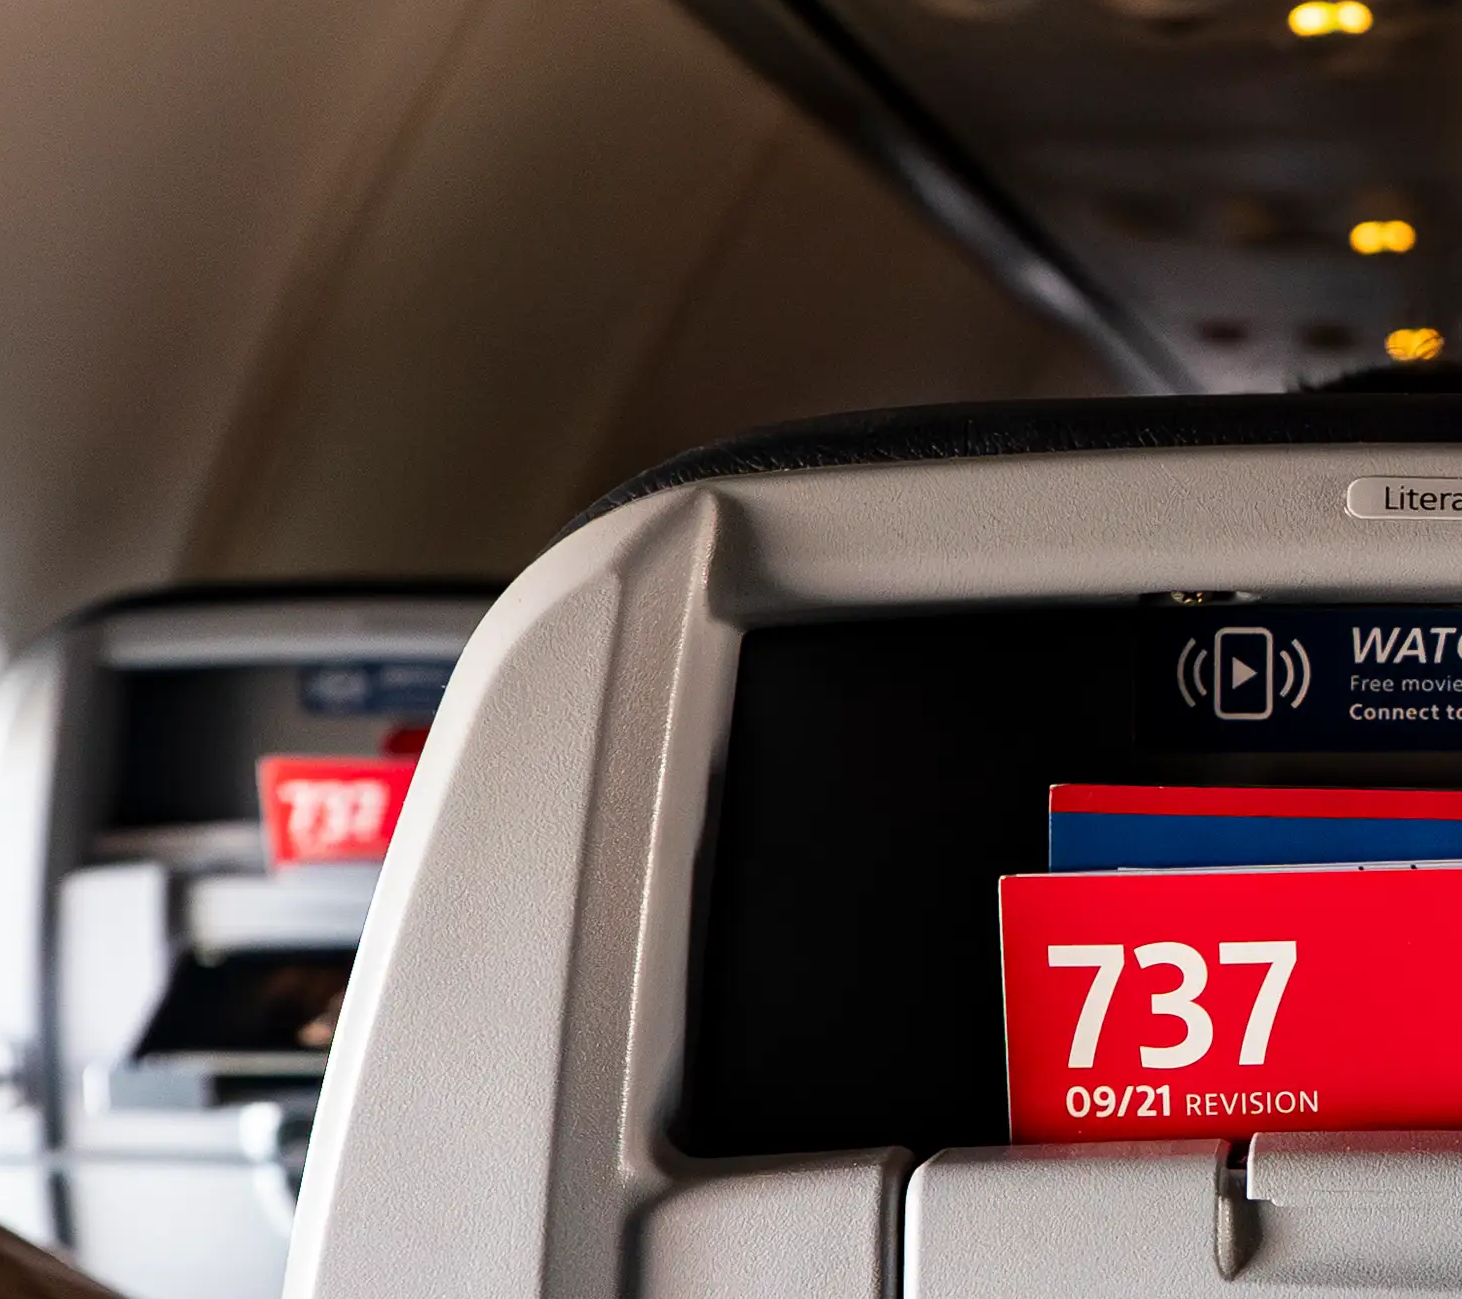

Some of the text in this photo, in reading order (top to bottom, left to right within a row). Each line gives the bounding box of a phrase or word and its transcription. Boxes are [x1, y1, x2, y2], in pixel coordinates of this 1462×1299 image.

[1350, 674, 1395, 693] Free
[1349, 703, 1440, 721] Connect
[1046, 939, 1299, 1071] 737
[1064, 1084, 1320, 1119] 09/21 REVISION
